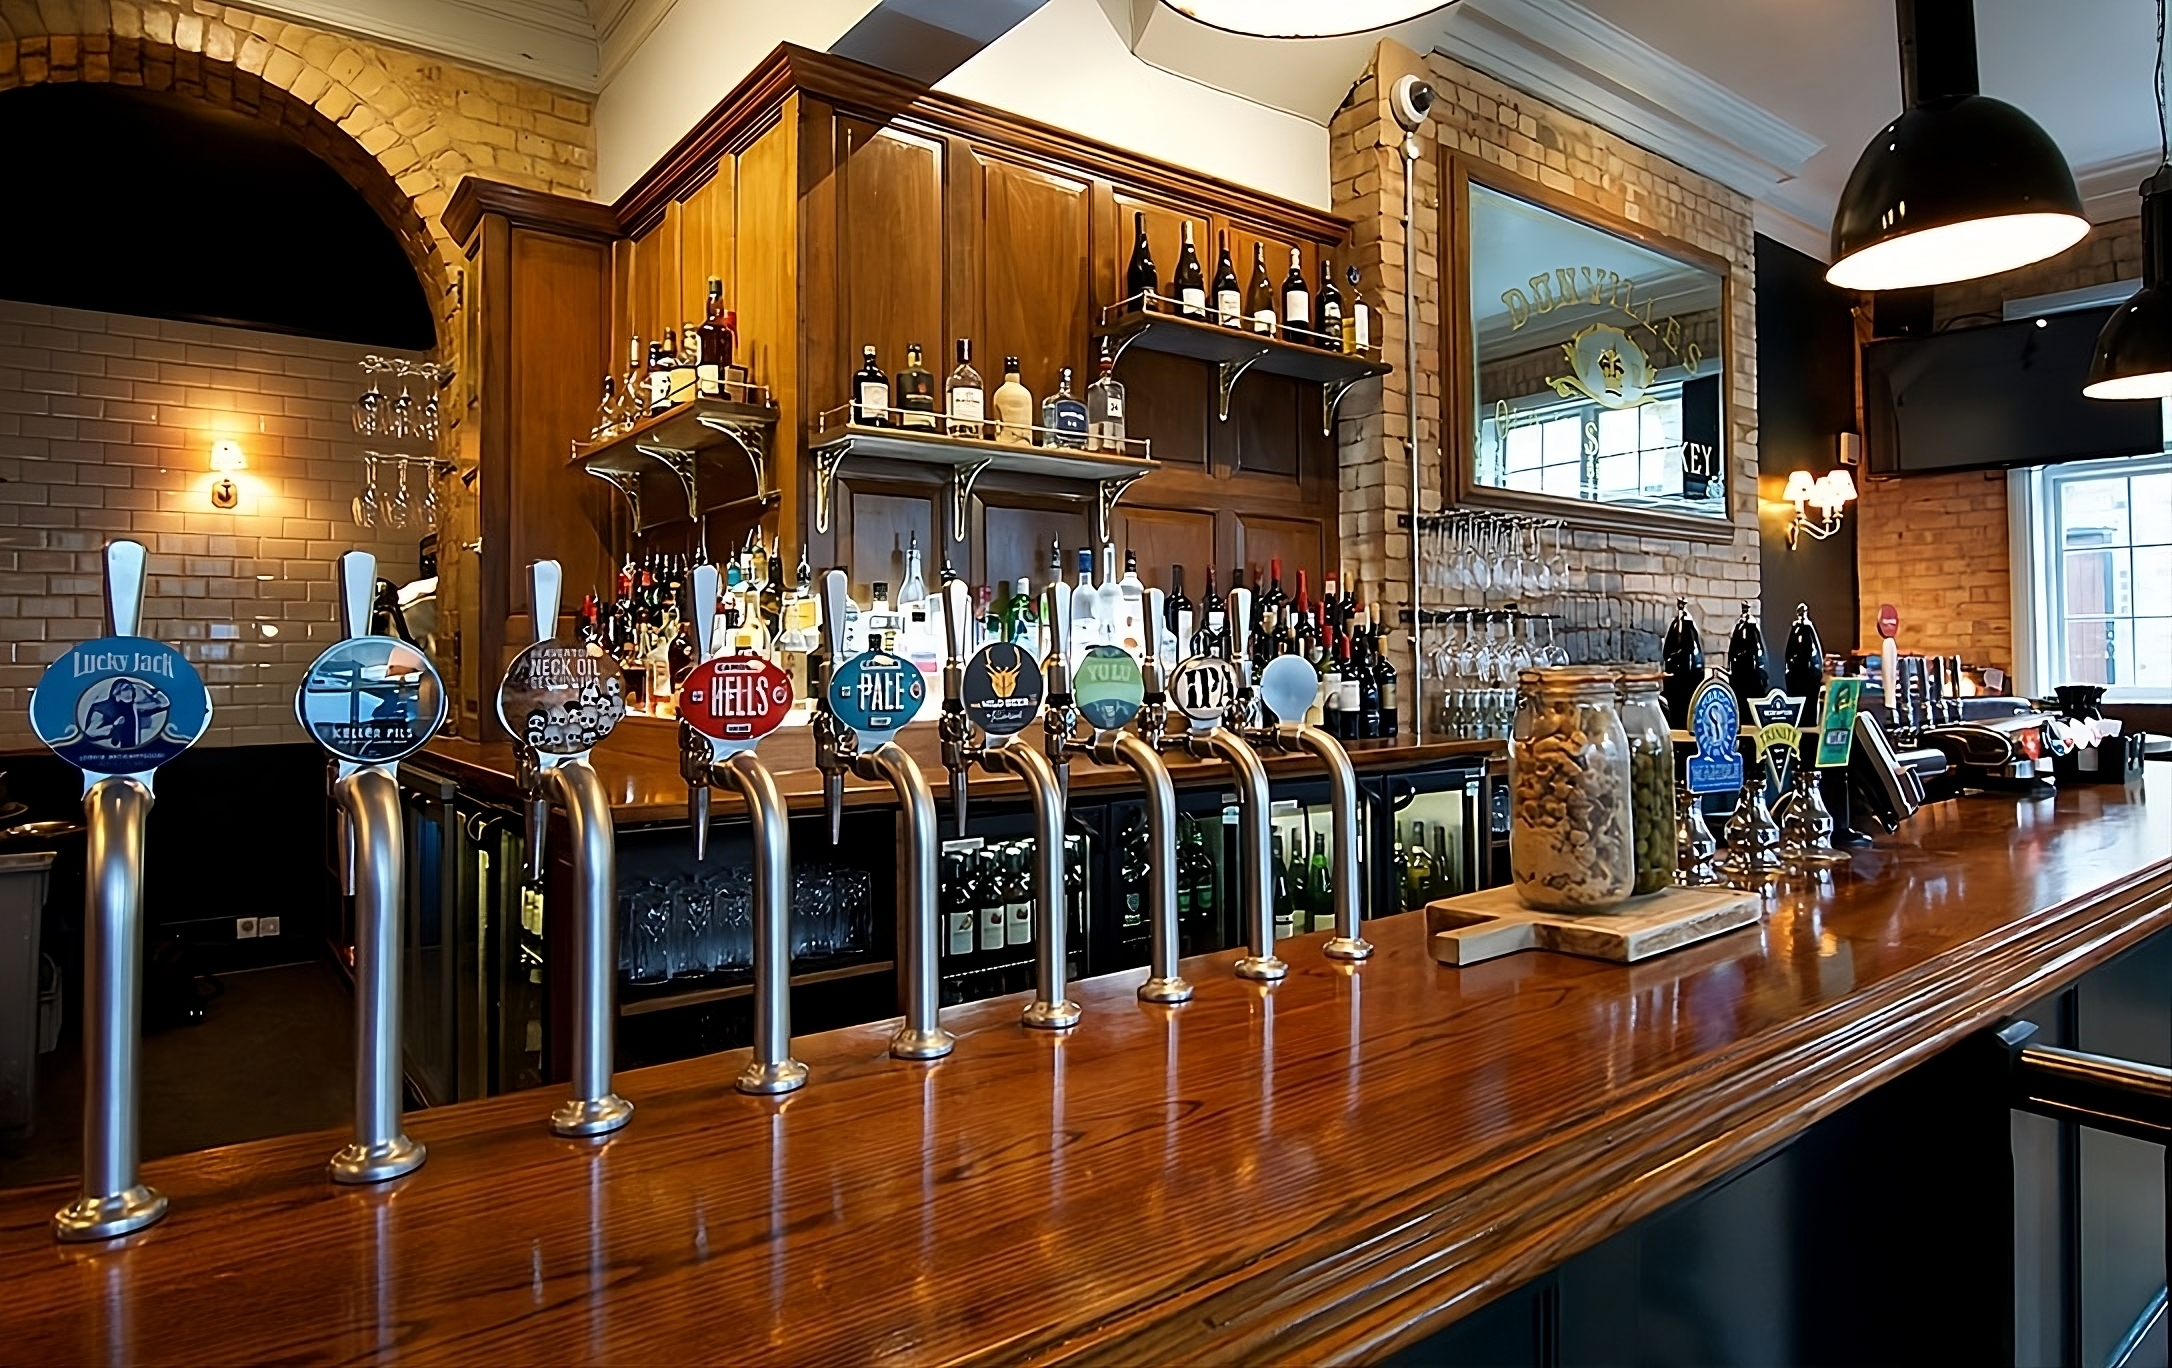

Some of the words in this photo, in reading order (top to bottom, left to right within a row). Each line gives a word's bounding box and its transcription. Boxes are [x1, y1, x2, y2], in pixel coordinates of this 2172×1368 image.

[529, 658, 572, 677] NECK
[576, 658, 601, 677] OIL
[1087, 663, 1132, 682] YULU
[711, 675, 769, 716] HELLS
[859, 672, 905, 711] PALE
[1184, 664, 1234, 709] IPA
[332, 727, 381, 739] KELLER
[386, 727, 413, 739] PILS
